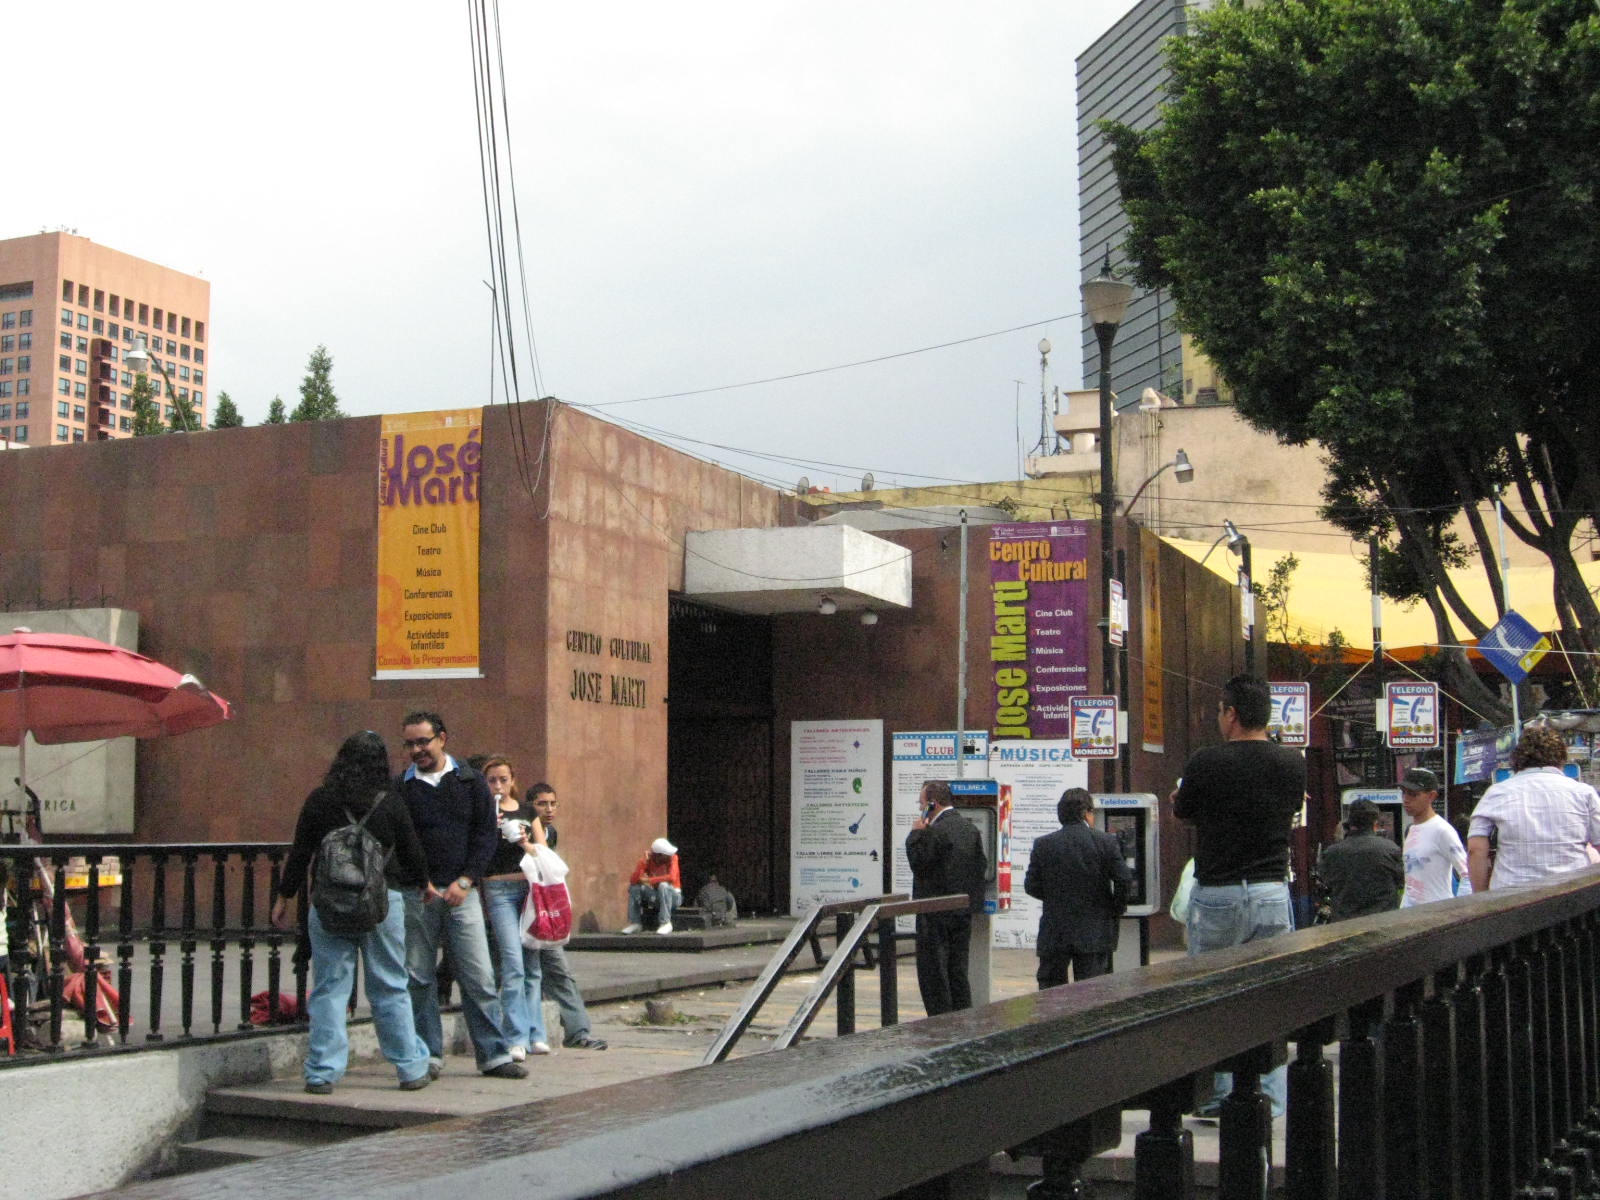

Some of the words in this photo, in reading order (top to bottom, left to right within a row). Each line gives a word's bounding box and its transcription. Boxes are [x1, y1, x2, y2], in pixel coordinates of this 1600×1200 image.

[387, 427, 481, 479] José
[412, 525, 429, 535] Cine
[430, 523, 447, 533] Club
[417, 546, 441, 556] Teatro
[990, 540, 1051, 562] Centro
[416, 567, 442, 577] Música
[1018, 557, 1088, 582] Cultural
[404, 589, 453, 600] Conferencias
[404, 611, 452, 622] Exposiciones
[1035, 609, 1053, 617] Cine
[1055, 608, 1073, 617] Club
[406, 629, 449, 640] Actividades
[1035, 628, 1061, 636] Teatro
[410, 641, 445, 651] Infantiles
[566, 630, 602, 656] CENTRO
[610, 637, 652, 664] CULTURAL
[1035, 647, 1064, 655] Música
[1036, 665, 1087, 674] Conferencias
[570, 668, 602, 704] JOSE
[609, 674, 646, 709] MARTI
[1036, 684, 1087, 693] Exposiciones
[1391, 686, 1434, 694] TELEFONO
[1073, 699, 1114, 707] TELEFONO
[1036, 704, 1069, 713] Activida
[1043, 711, 1069, 719] Infanti
[926, 746, 954, 755] CLUB
[1000, 746, 1073, 761] MÚSICA
